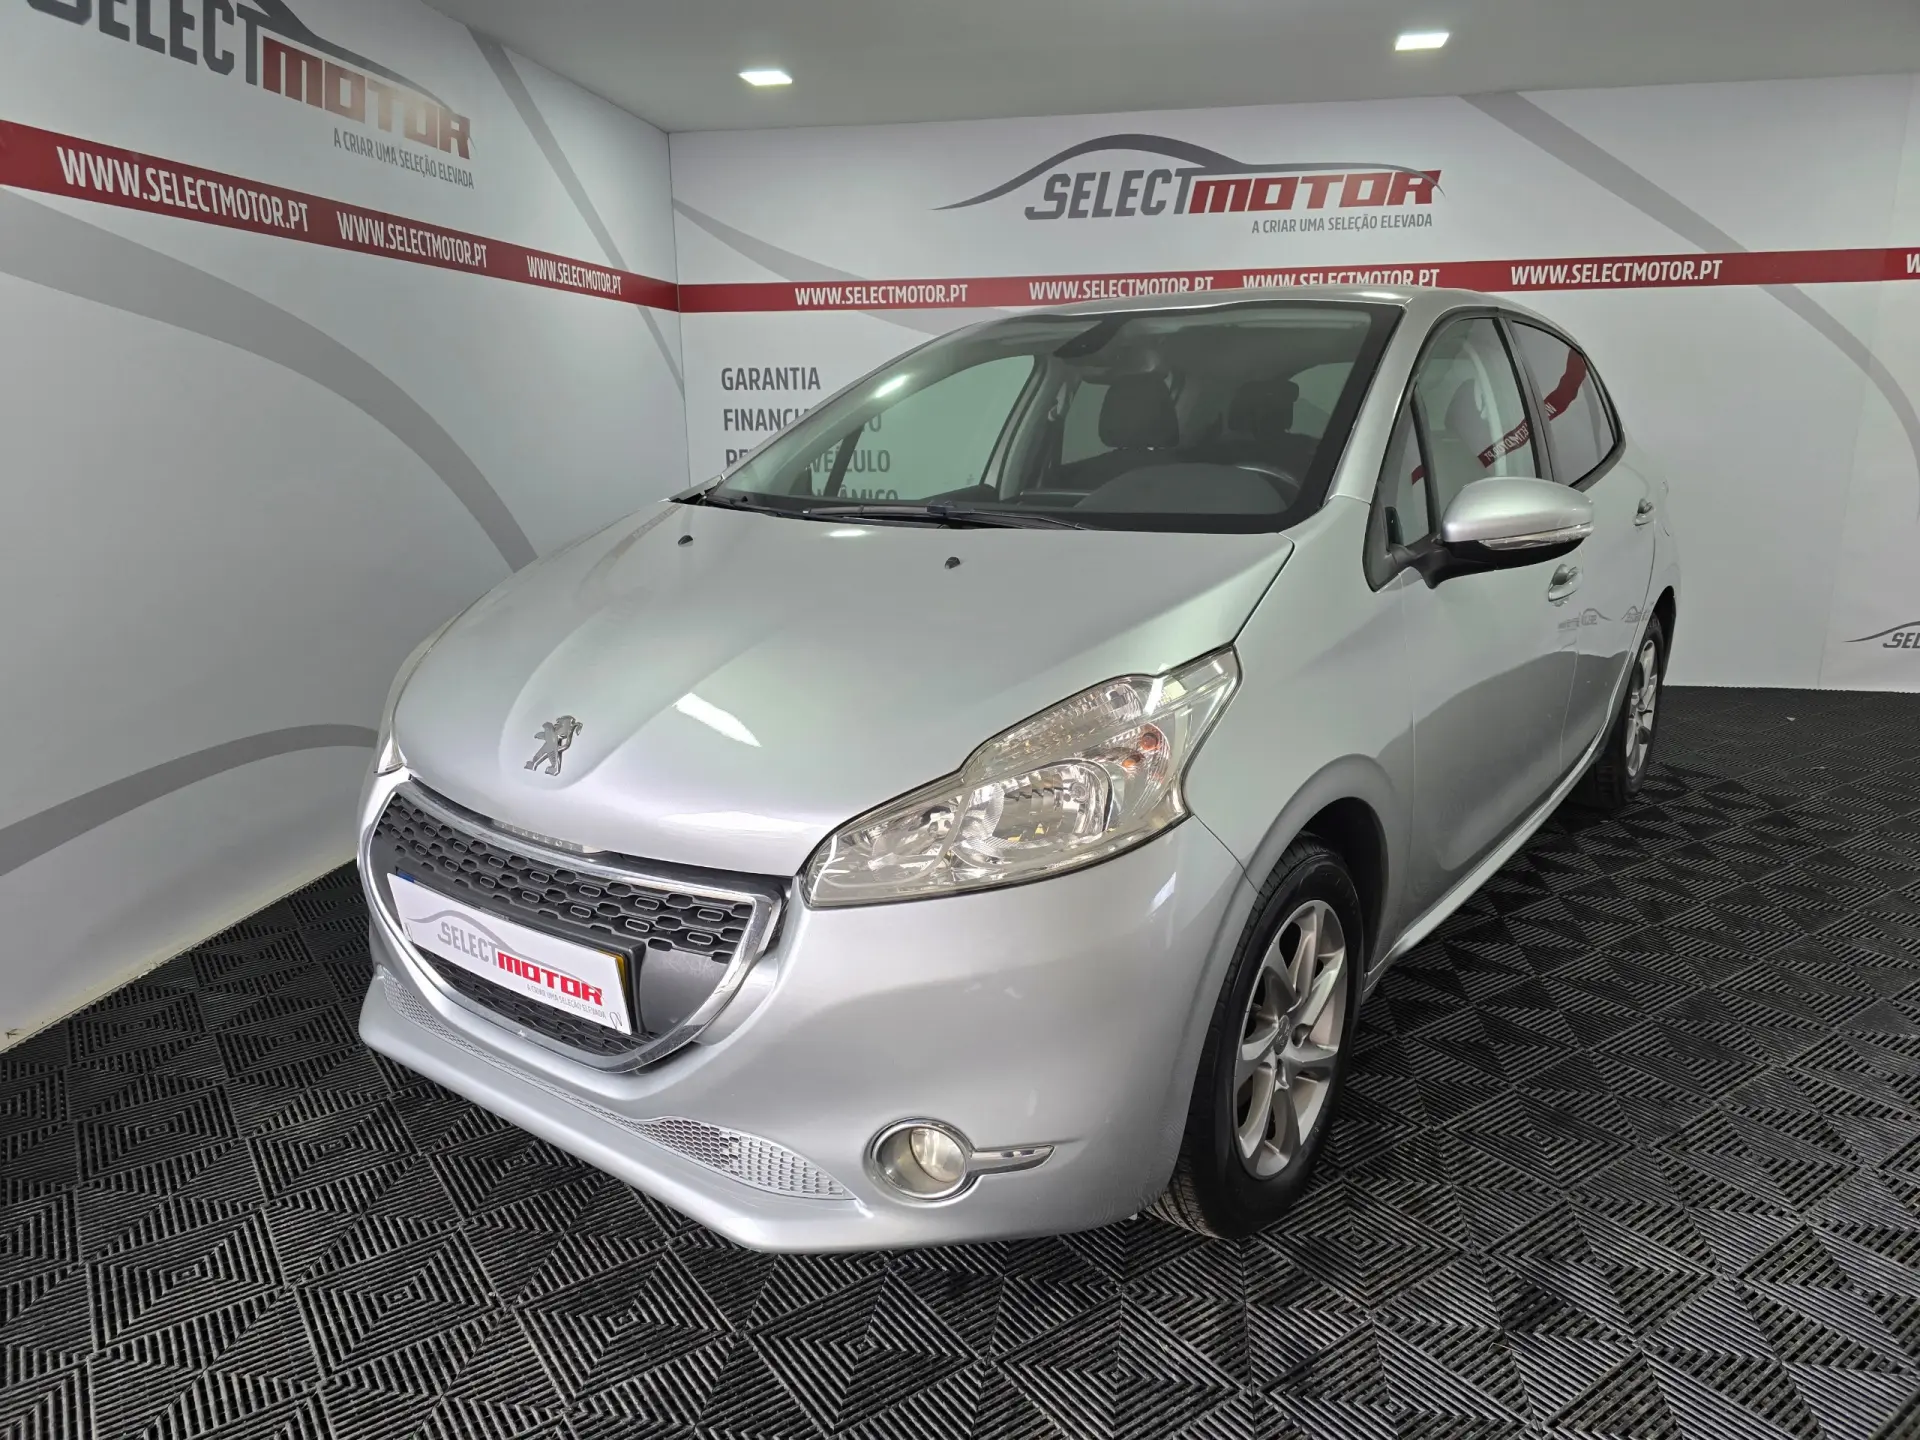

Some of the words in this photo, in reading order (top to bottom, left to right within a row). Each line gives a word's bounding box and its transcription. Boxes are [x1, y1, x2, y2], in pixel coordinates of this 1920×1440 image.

[333, 127, 341, 148] A
[343, 131, 374, 158] CRIAR
[375, 141, 398, 166] UMA
[399, 149, 437, 178] SELEÇÃO
[438, 162, 474, 189] ELEVADA
[56, 146, 308, 232] WWW.SELECTMOTOR.PT
[1024, 167, 1441, 220] SELECTMOTOR
[336, 211, 487, 268] WWW.SELECTMOTOR.PT
[1251, 220, 1260, 234] A
[1263, 218, 1296, 233] CRIAR
[1300, 217, 1325, 232] UMA
[1328, 214, 1378, 232] SELEÇÃO
[1380, 213, 1433, 229] ELEVADA
[526, 255, 622, 295] WWW.SELECTMOTOR.PT
[1029, 276, 1214, 300] WWW.SELECTMOTORPT
[1243, 268, 1440, 288] WWWSELECTMOTORPT
[1511, 259, 1722, 286] WWW.SELECTMOTOR.PT
[794, 284, 968, 306] WWW.SELECTMOTOR.PT
[721, 367, 821, 391] GARANTIA
[437, 921, 603, 1006] SELECTMOTOR
